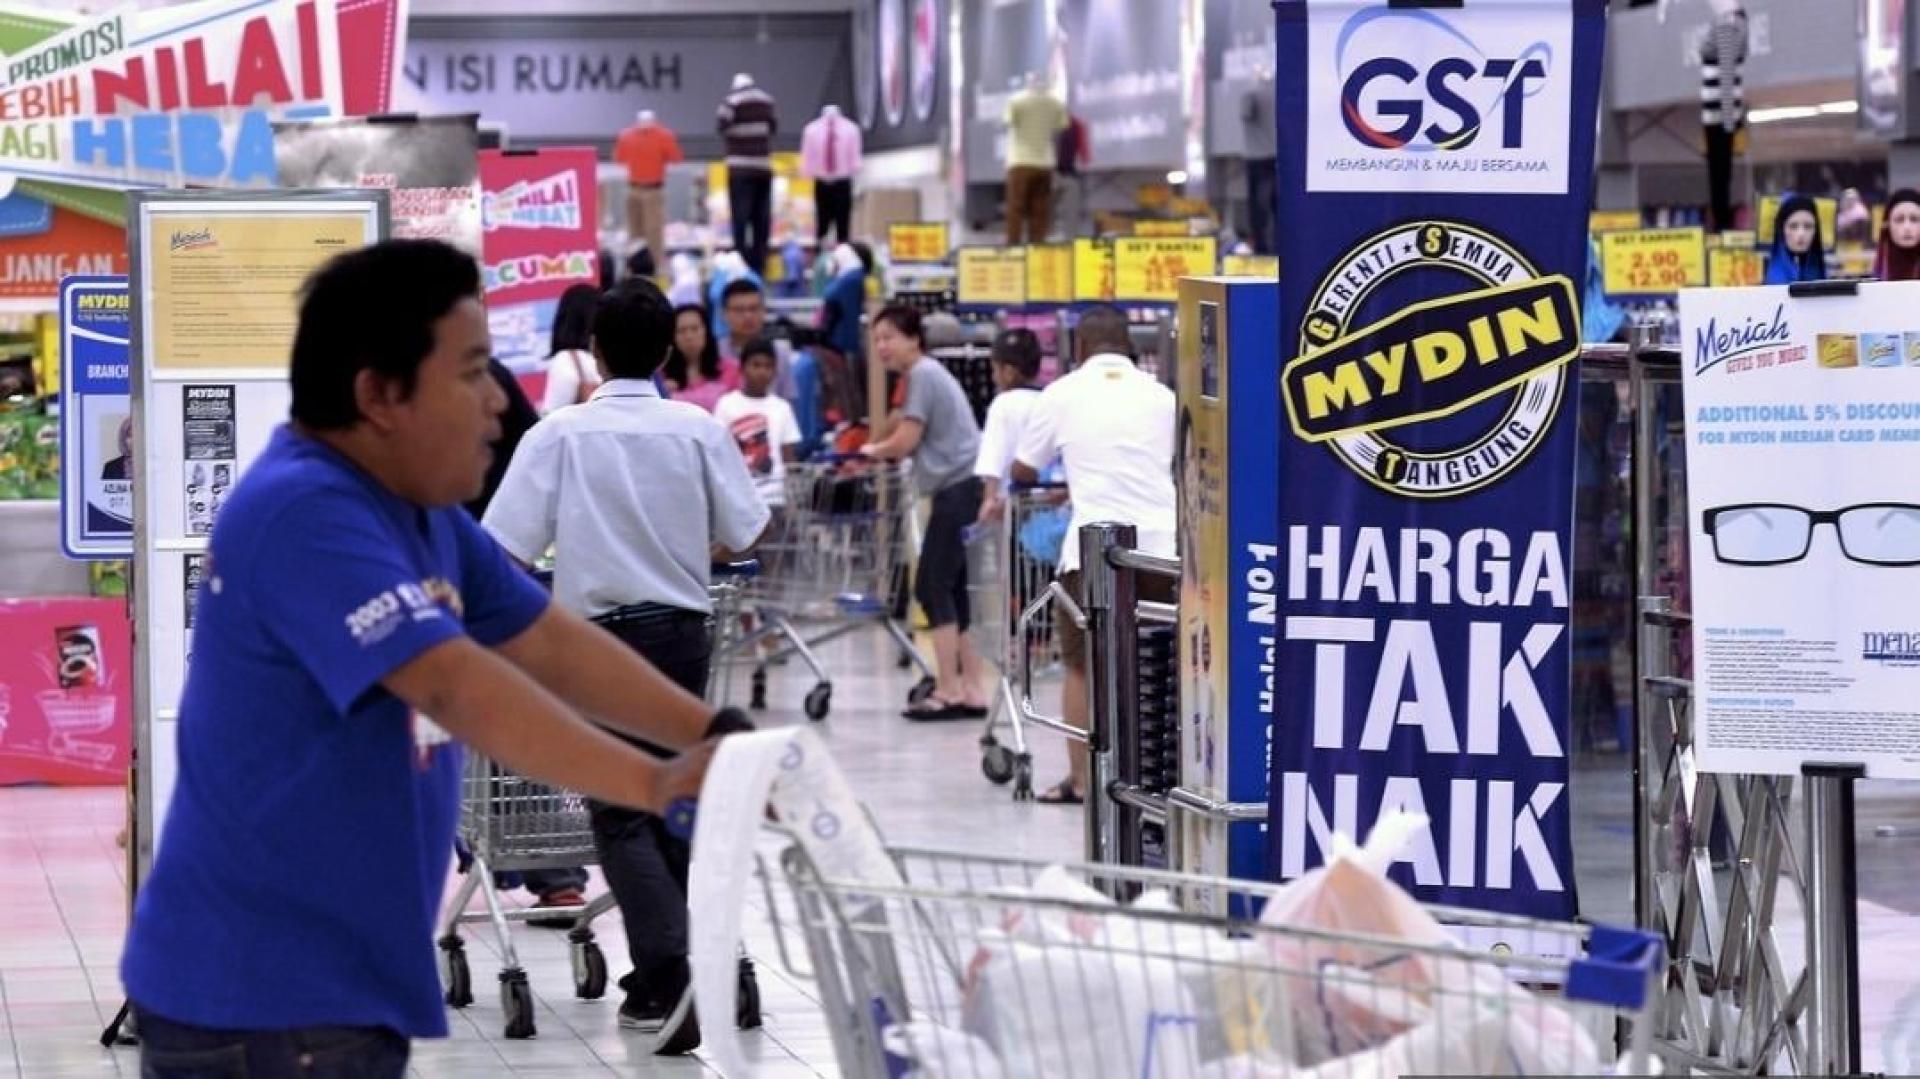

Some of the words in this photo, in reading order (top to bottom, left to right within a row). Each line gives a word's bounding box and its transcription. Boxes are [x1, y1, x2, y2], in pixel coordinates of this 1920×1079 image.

[8, 16, 124, 85] PROMOSI
[92, 3, 323, 115] NILAI
[446, 55, 495, 92] ISI
[514, 53, 682, 92] RUMAH
[1341, 56, 1546, 150] GST
[0, 122, 58, 161] AGI
[73, 106, 330, 184] HEBA
[1326, 158, 1419, 172] MEMBANGUN
[1423, 159, 1432, 172] &
[1437, 158, 1477, 172] MAJU
[1481, 159, 1549, 173] BERSAMA
[1303, 244, 1394, 340] GERENTI
[1424, 226, 1515, 283] SEMUA
[1303, 296, 1564, 420] MYDIN
[1695, 303, 1790, 368] Meriah
[1382, 419, 1533, 485] TANGGUNG
[1697, 406, 1809, 422] ADDITIONAL
[1814, 404, 1841, 420] 5%
[1287, 524, 1569, 608] HARGA
[1285, 614, 1566, 758] TAK
[1281, 771, 1565, 893] NAIK
